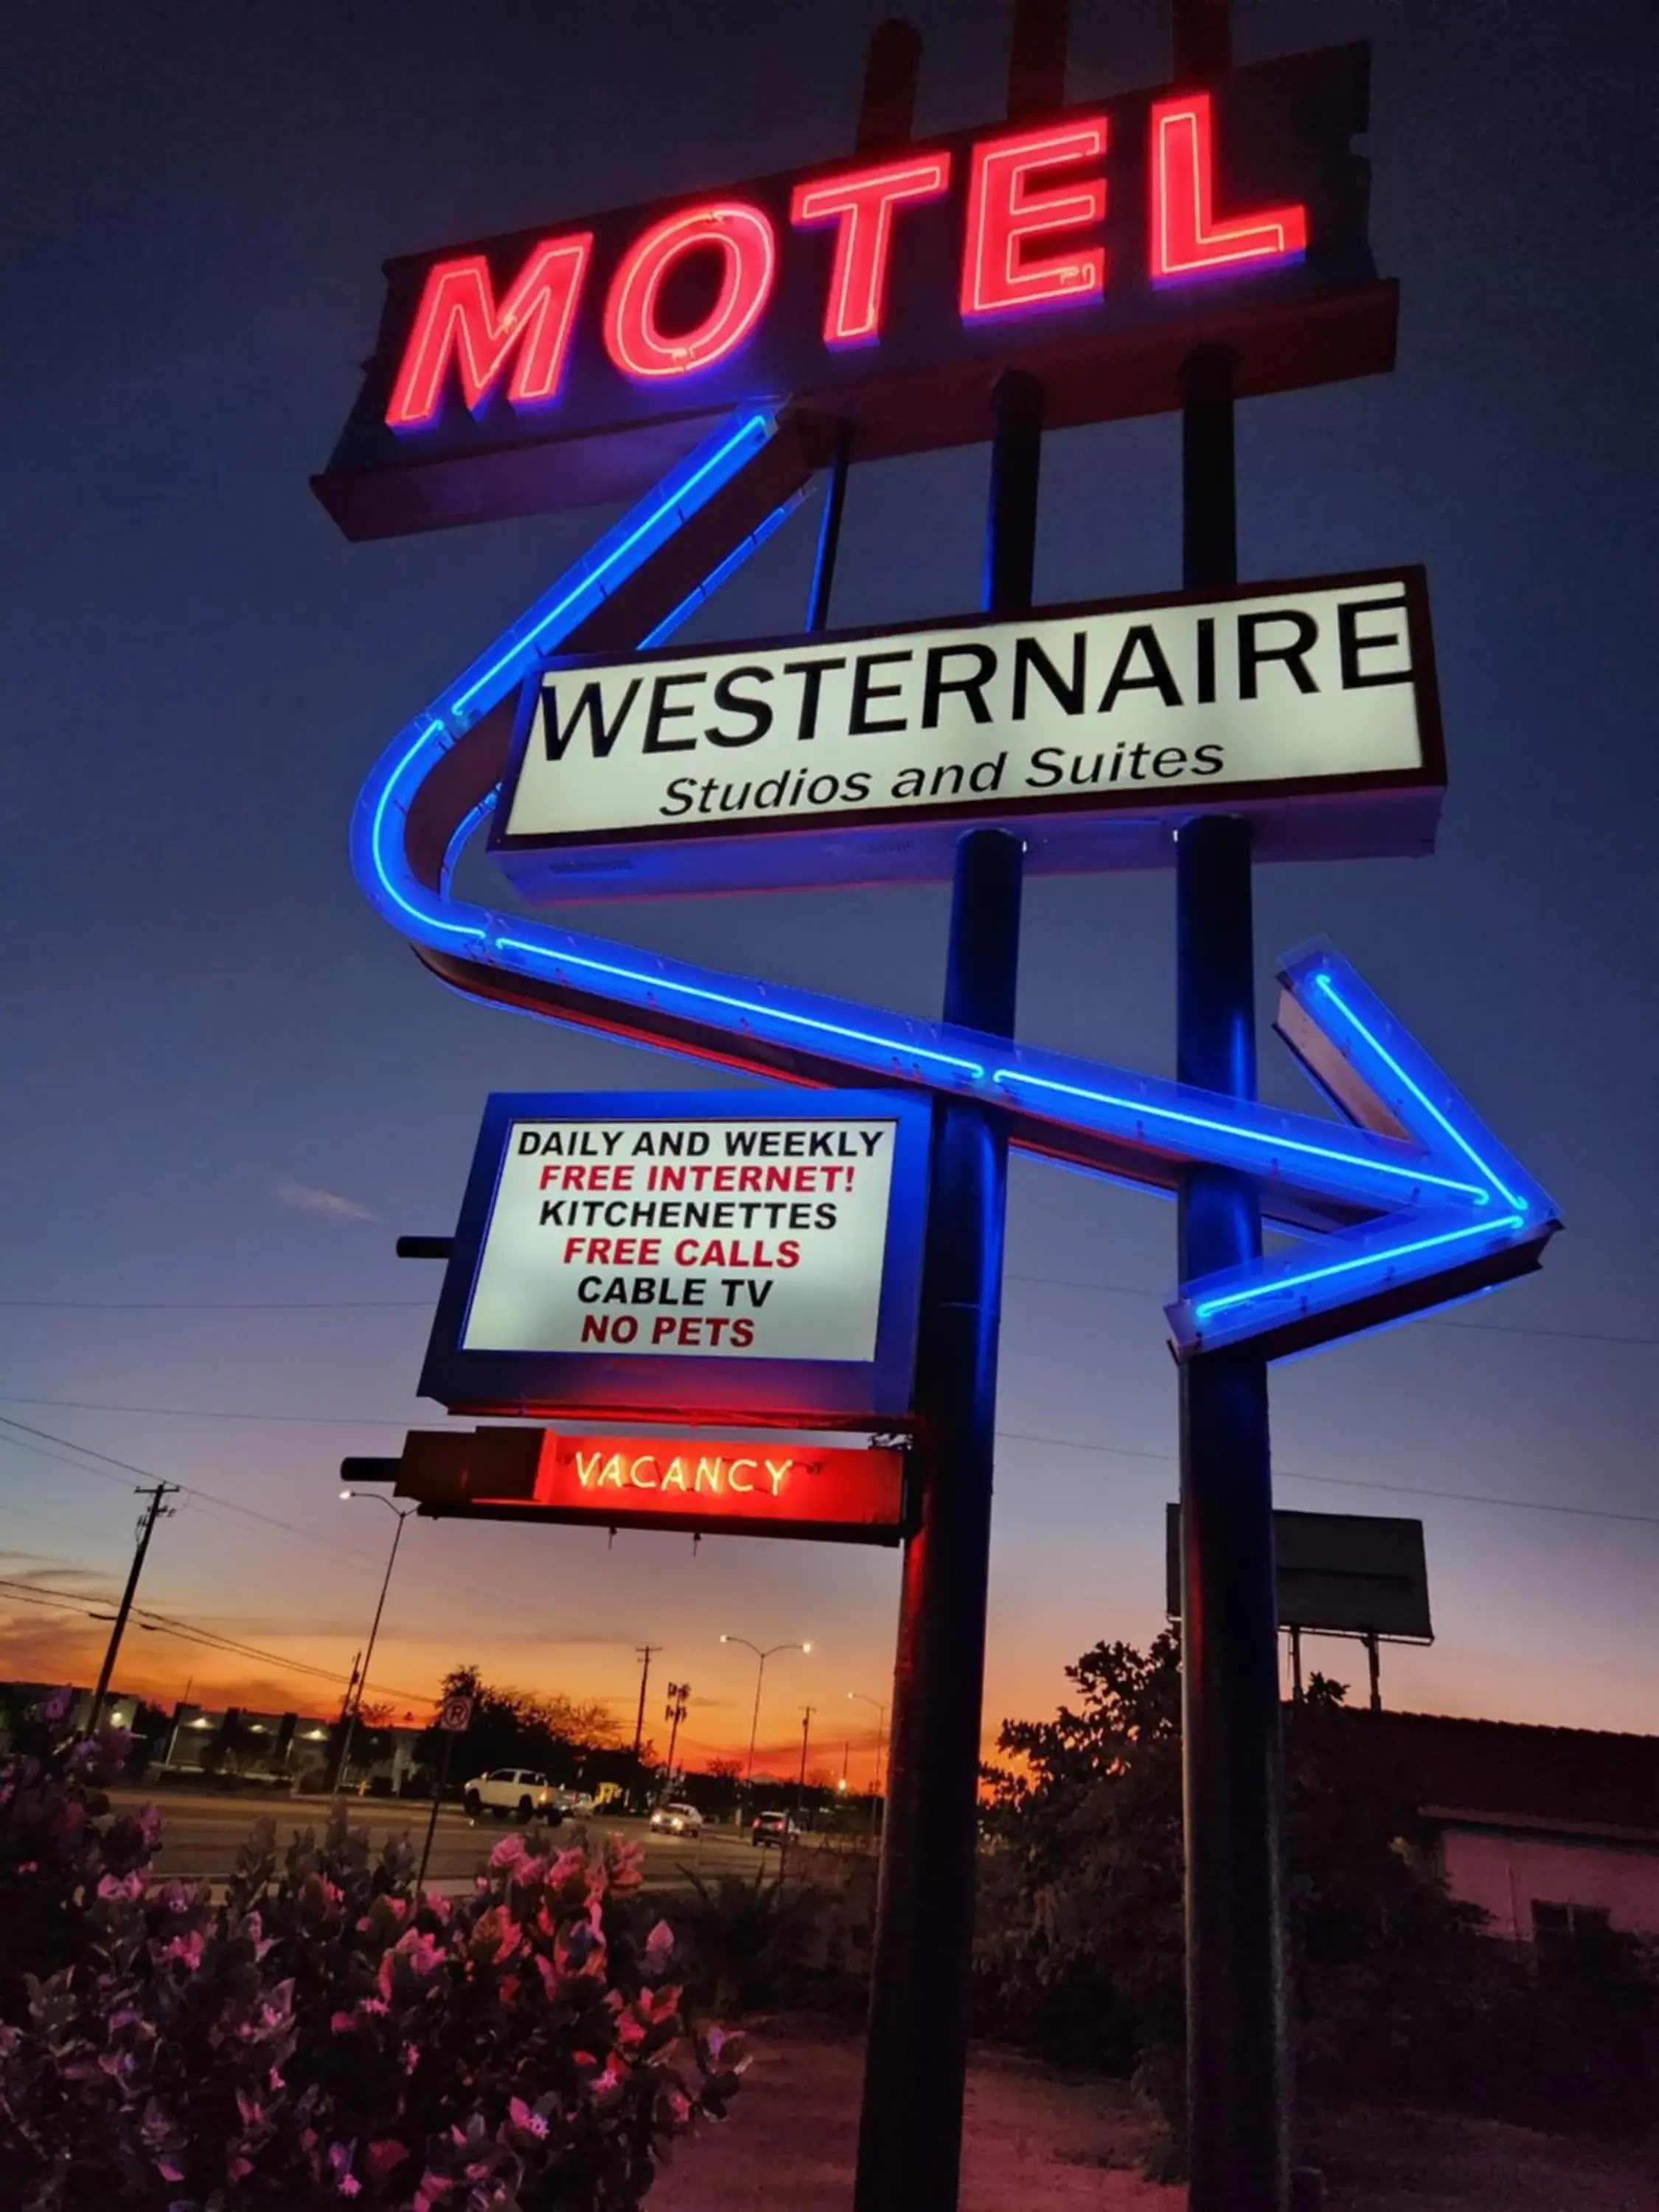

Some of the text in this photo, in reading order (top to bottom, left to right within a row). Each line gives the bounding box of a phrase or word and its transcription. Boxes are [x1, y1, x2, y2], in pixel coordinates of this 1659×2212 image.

[386, 93, 1307, 426] MOTEL
[540, 596, 1413, 761] WESTERNAIRE
[659, 741, 1225, 816] Studios and Suites
[518, 1131, 884, 1158] DAILY AND WEEKLY
[540, 1165, 855, 1192] FREE INTERNET!
[539, 1200, 837, 1229] KITCHENETTES
[563, 1237, 800, 1267] FREE CALLS
[577, 1276, 773, 1308] CABLE TV
[580, 1315, 755, 1348] NO PETS
[575, 1451, 793, 1496] VACANCY
